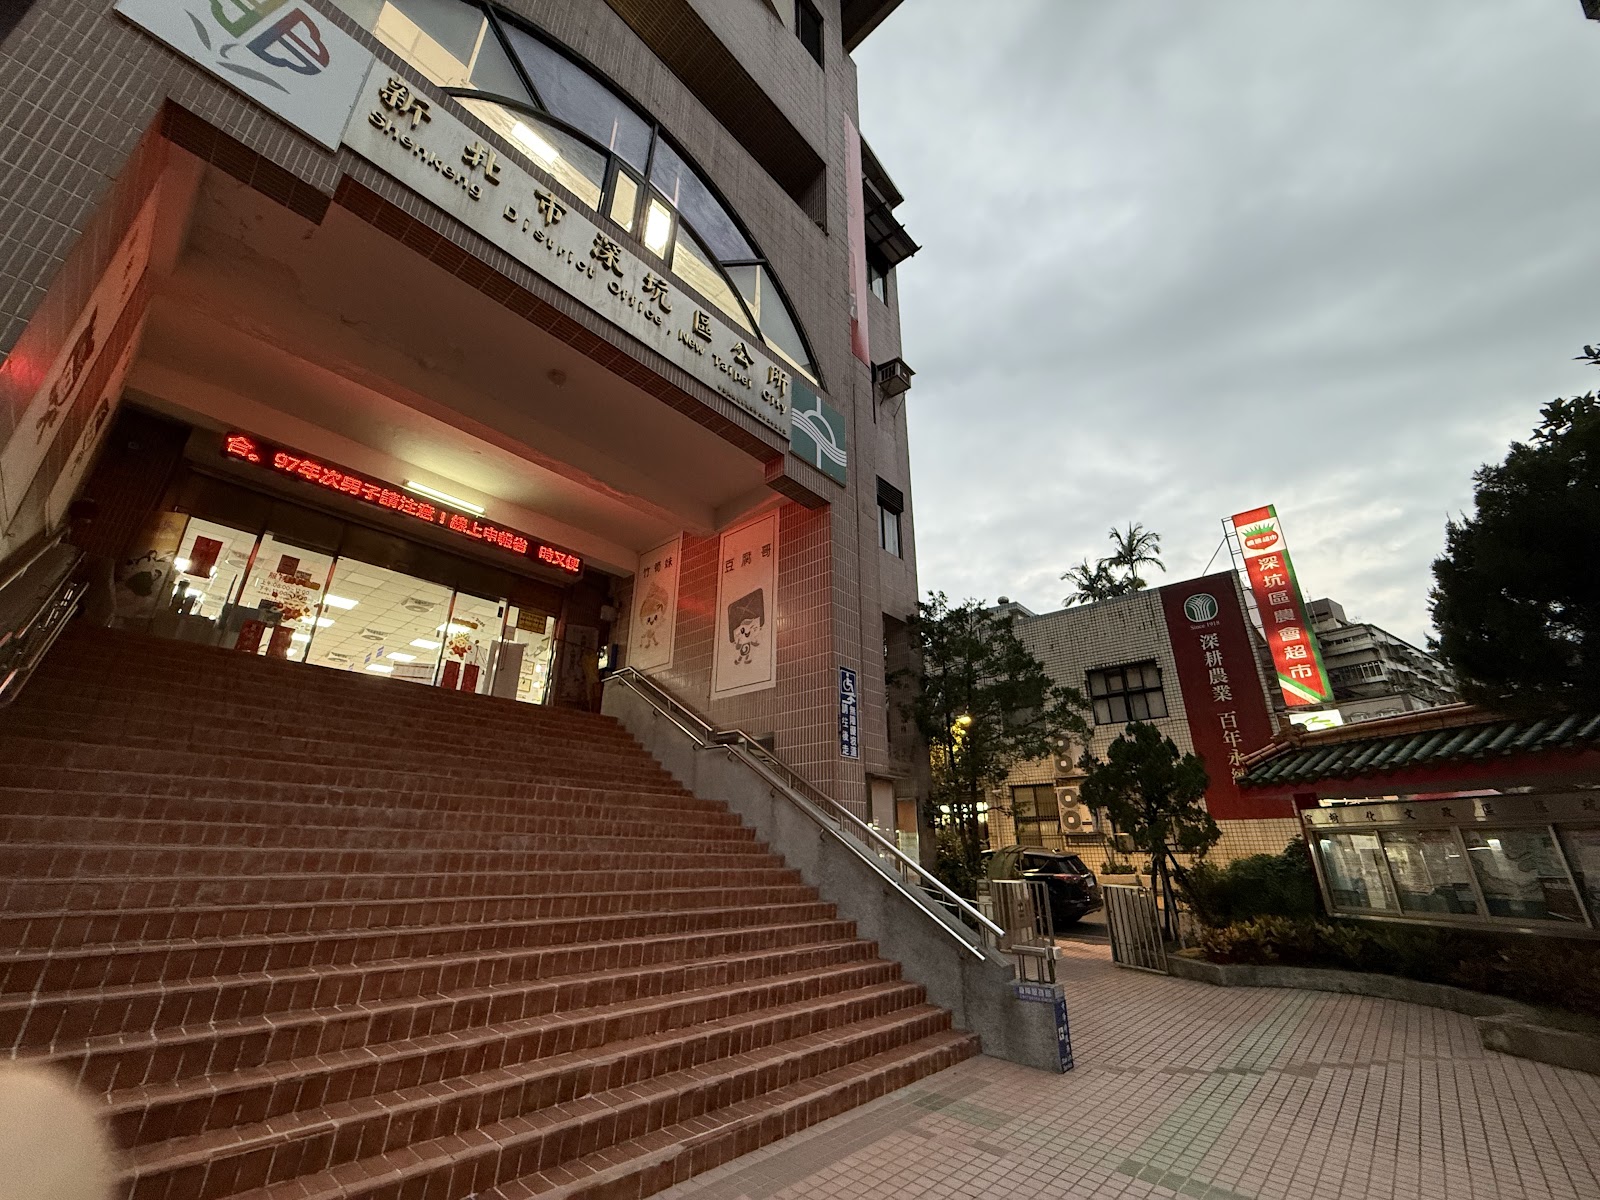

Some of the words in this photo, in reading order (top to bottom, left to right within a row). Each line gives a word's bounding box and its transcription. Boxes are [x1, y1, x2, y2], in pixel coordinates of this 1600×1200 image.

[368, 110, 484, 201] Shenkeng
[503, 204, 595, 279] District
[677, 328, 707, 356] New
[712, 354, 753, 389] Taipei
[761, 389, 788, 415] City
[379, 75, 789, 398] 新北市深坑區公所
[643, 556, 673, 578] 竹筍妹
[724, 543, 772, 573] 豆腐哥
[1190, 623, 1206, 631] Since
[1257, 555, 1313, 679] 深坑區農會超市
[1199, 632, 1233, 702] 深耕農業
